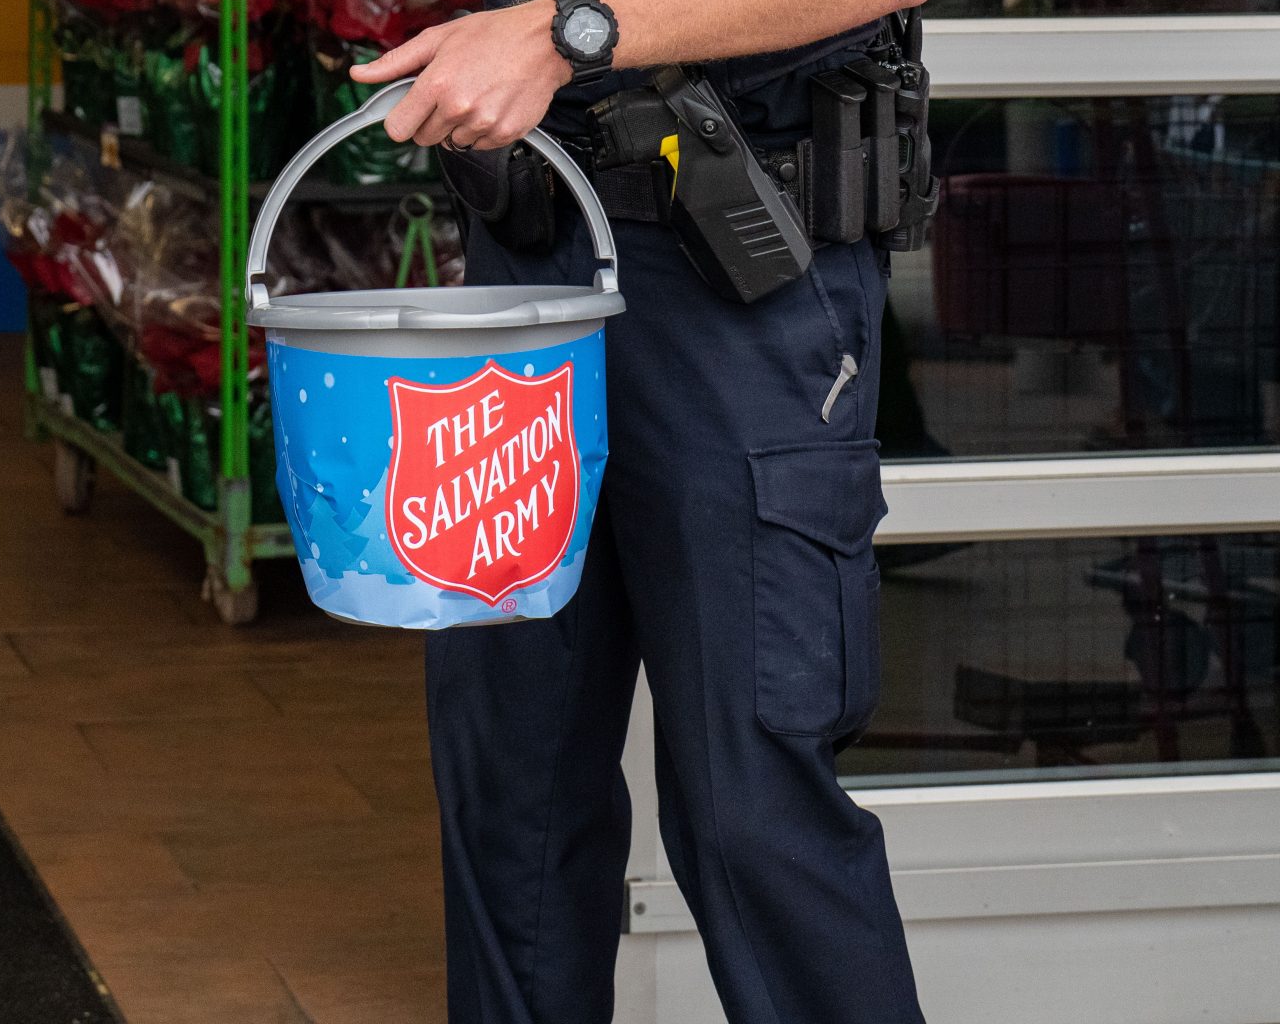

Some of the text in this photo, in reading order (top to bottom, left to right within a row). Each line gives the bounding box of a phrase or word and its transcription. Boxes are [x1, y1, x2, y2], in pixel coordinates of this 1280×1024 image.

[402, 391, 563, 550] SALVATION
[426, 389, 506, 469] THE
[466, 460, 561, 580] ARMY
